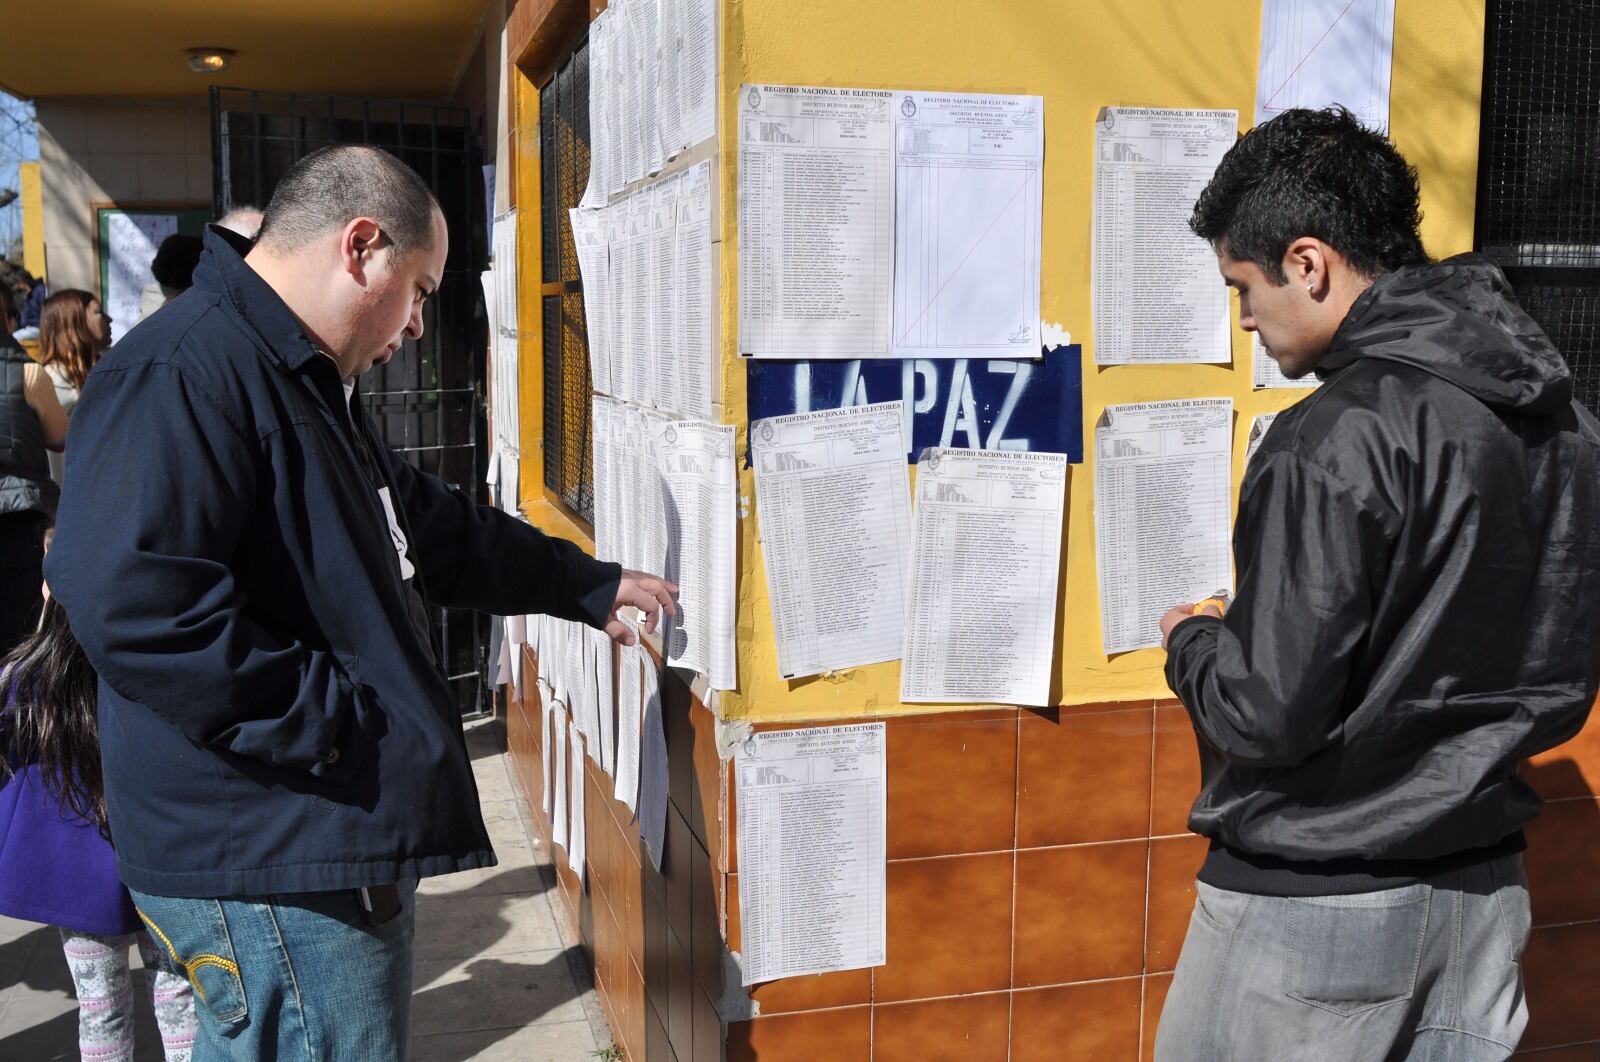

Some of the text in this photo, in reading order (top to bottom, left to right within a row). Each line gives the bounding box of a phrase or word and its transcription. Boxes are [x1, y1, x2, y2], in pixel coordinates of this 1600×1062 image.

[763, 86, 799, 94] REGISTRO
[802, 88, 837, 96] NACIONAL
[852, 90, 893, 98] ELECTORES
[903, 359, 1034, 454] PAZ
[1148, 402, 1180, 410] NACIONAL
[775, 414, 810, 424] REGISTRO
[812, 410, 848, 420] NACIONAL
[862, 403, 902, 413] ELECTORES
[978, 451, 1012, 459] NACIONAL
[1025, 454, 1065, 462] ELECTORES
[758, 731, 794, 740] REGISTRO
[844, 724, 884, 732] ELECTORES
